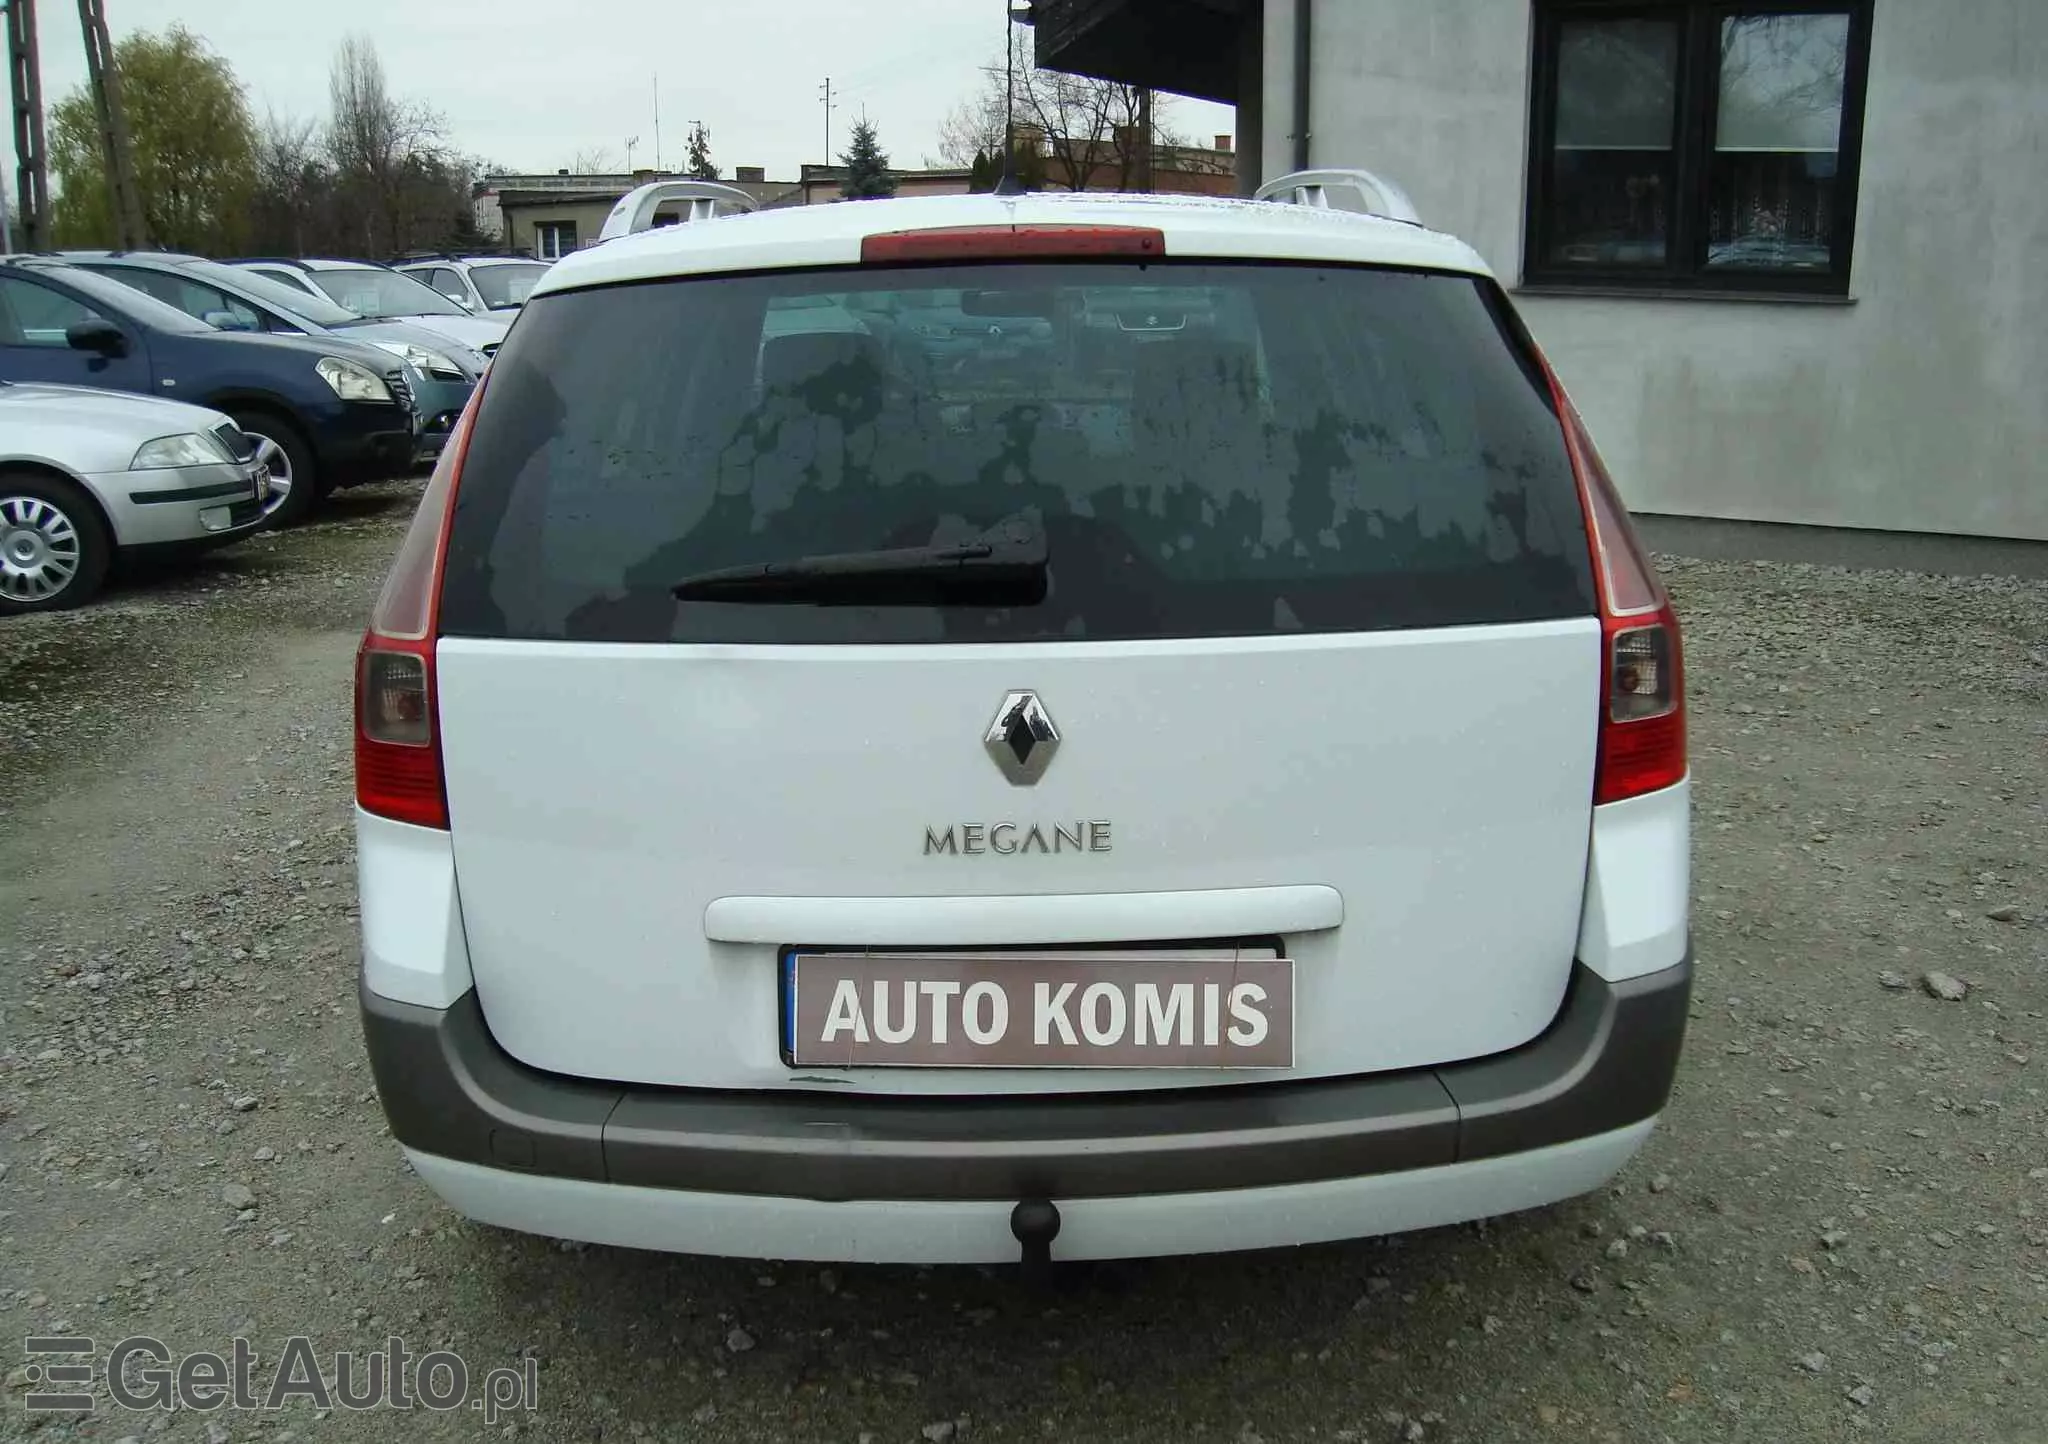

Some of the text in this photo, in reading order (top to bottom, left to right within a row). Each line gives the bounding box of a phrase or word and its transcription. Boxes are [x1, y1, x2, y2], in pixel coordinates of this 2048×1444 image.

[924, 820, 1112, 855] MEGANE
[821, 980, 1269, 1047] AUTO KOMIS
